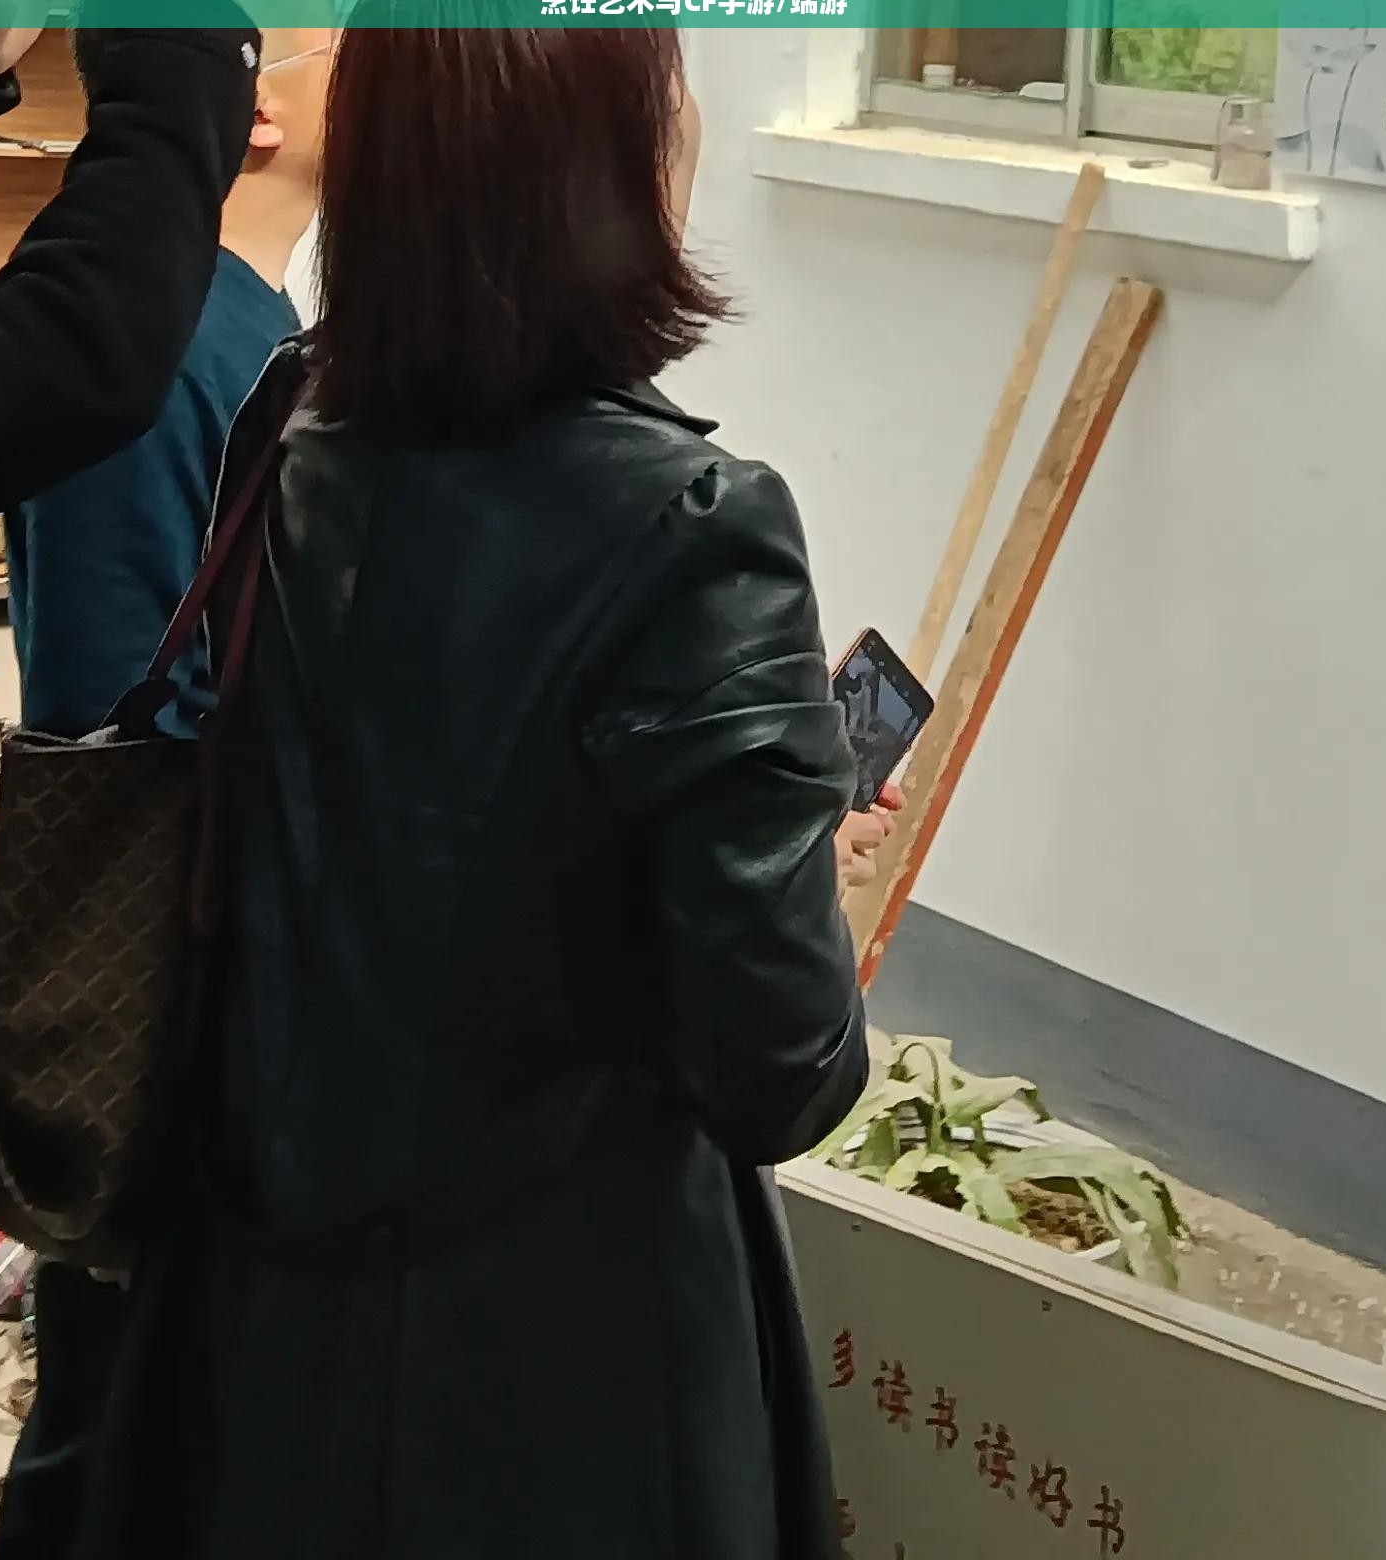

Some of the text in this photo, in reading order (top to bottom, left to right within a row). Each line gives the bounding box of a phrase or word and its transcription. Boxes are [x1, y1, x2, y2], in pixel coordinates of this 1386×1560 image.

[826, 1328, 1127, 1560] 多读书读好书
